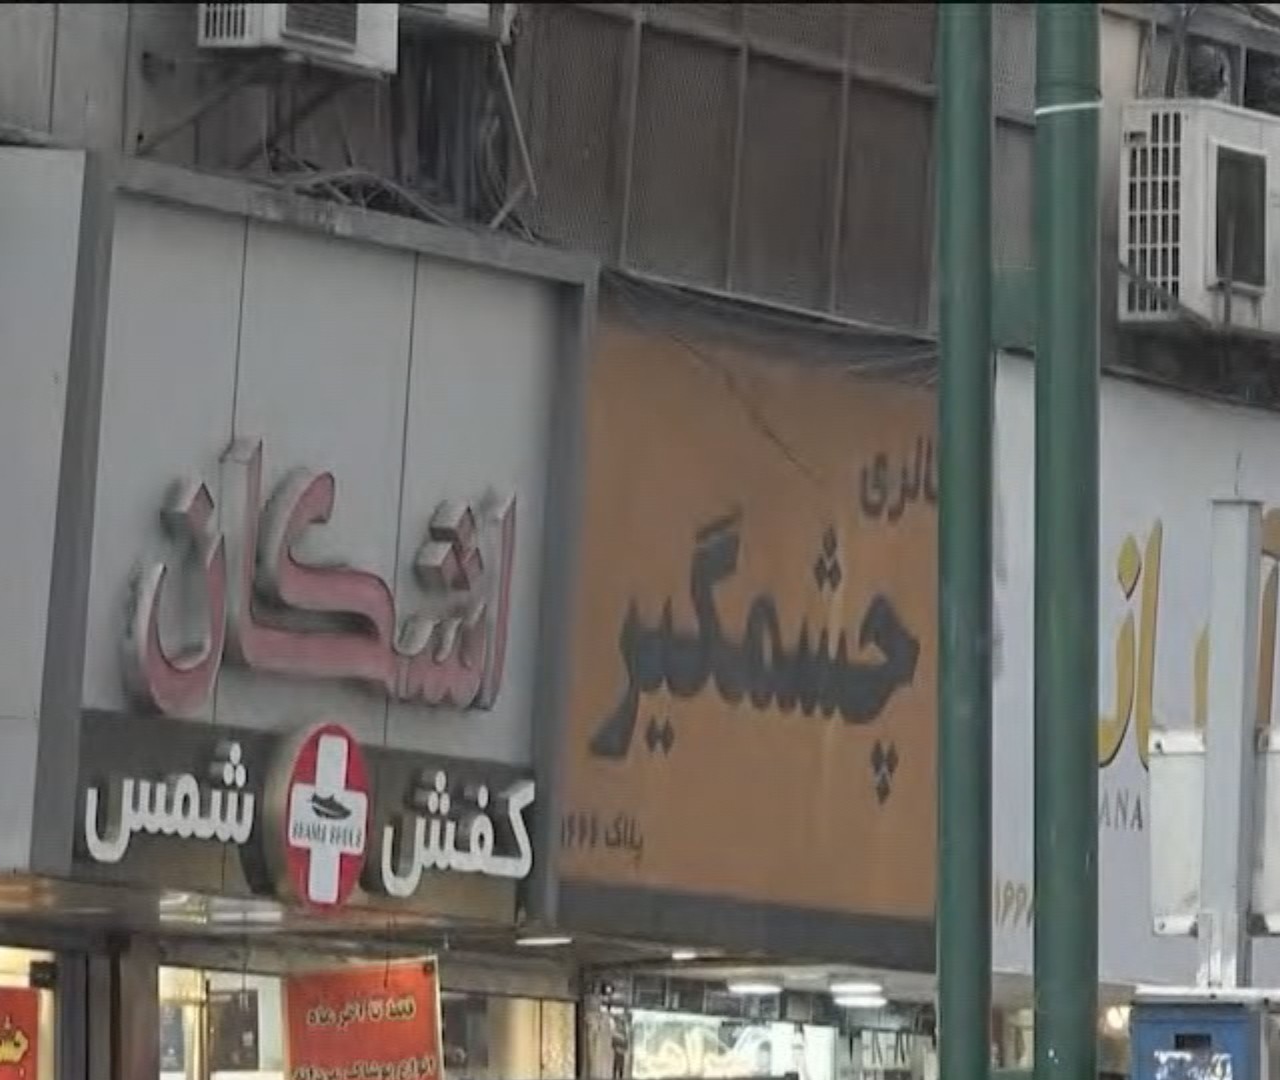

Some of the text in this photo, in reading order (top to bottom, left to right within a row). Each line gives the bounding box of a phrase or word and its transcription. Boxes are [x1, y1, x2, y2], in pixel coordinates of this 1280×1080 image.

[859, 434, 939, 524] الری
[121, 435, 518, 718] اشکان
[590, 498, 922, 807] چشمگیر
[84, 739, 536, 898] کفش شمس
[605, 811, 644, 864] پلاک
[306, 1003, 336, 1027] ماه
[367, 997, 384, 1022] تا
[385, 994, 416, 1021] فقط
